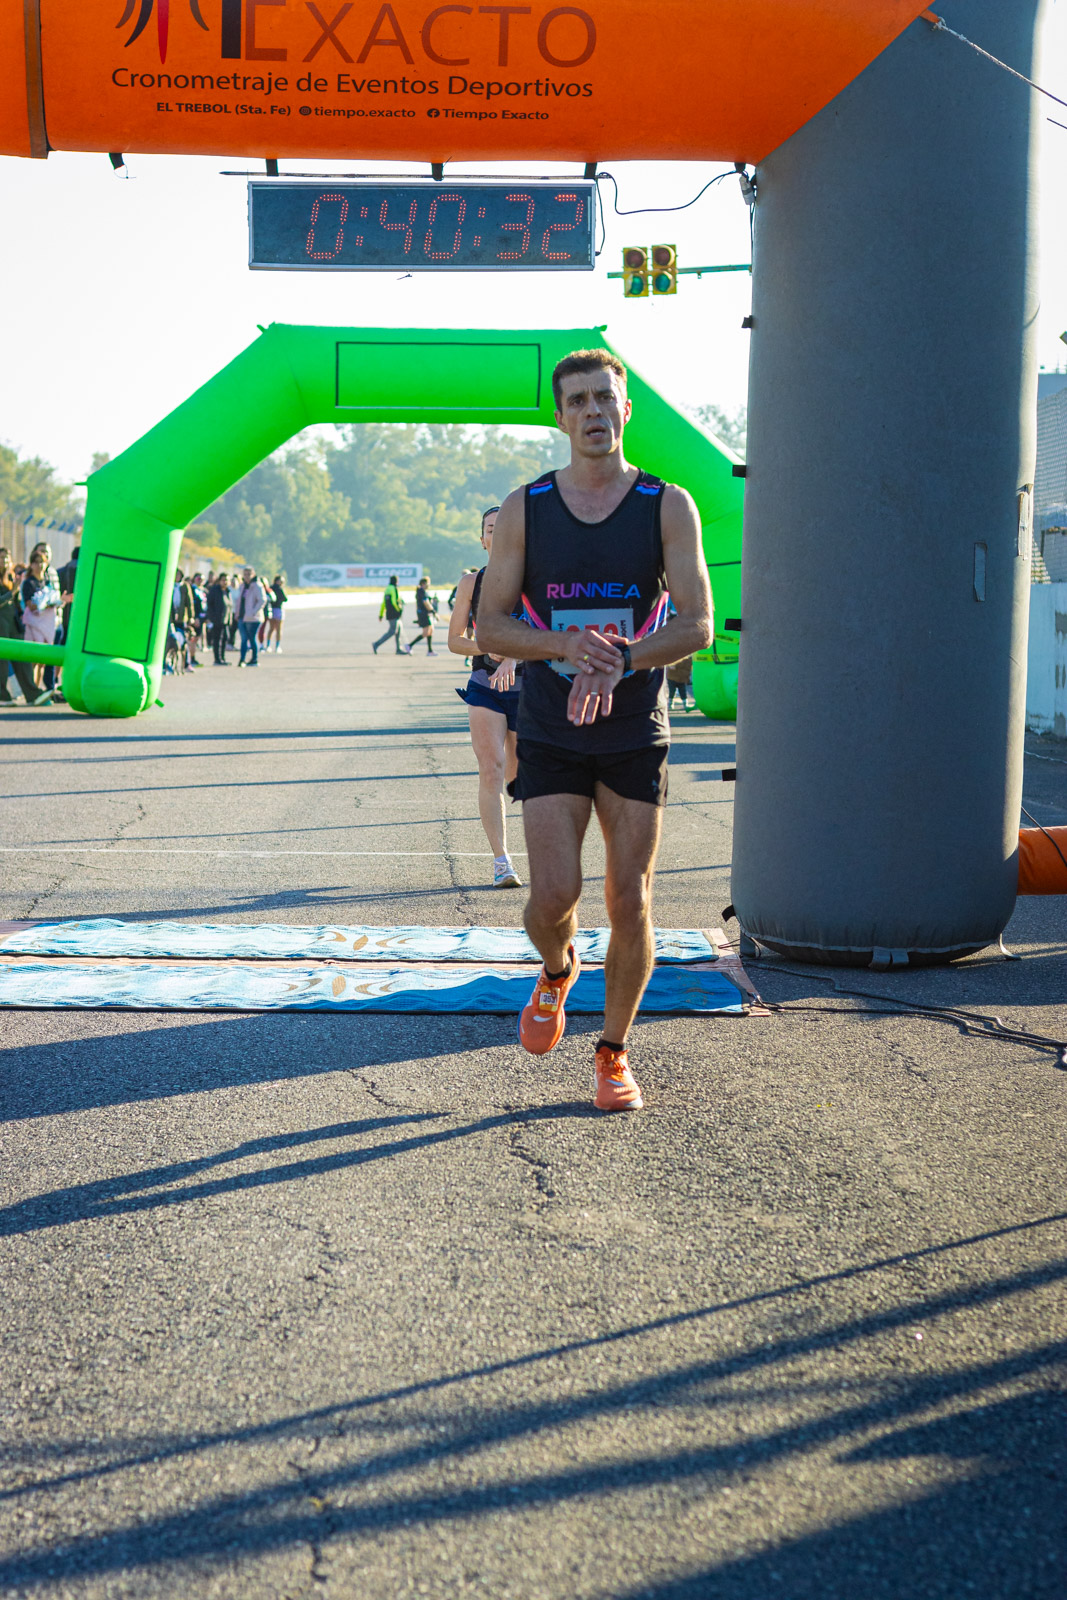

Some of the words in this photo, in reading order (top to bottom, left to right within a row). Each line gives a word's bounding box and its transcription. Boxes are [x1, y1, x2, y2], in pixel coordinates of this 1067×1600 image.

[112, 68, 288, 95] Cronometraje
[296, 72, 328, 92] de
[337, 74, 439, 94] Eventos
[449, 76, 593, 99] Deportivos
[157, 102, 172, 112] EL
[176, 103, 231, 113] TREBOL
[235, 104, 266, 115] (Sta.
[270, 105, 291, 116] Fe)
[314, 106, 416, 118] tiempo.exacto
[443, 108, 497, 120] Tiempo
[501, 109, 549, 120] Exacto
[306, 194, 584, 260] 0:40:32
[547, 582, 641, 599] RUNNEA
